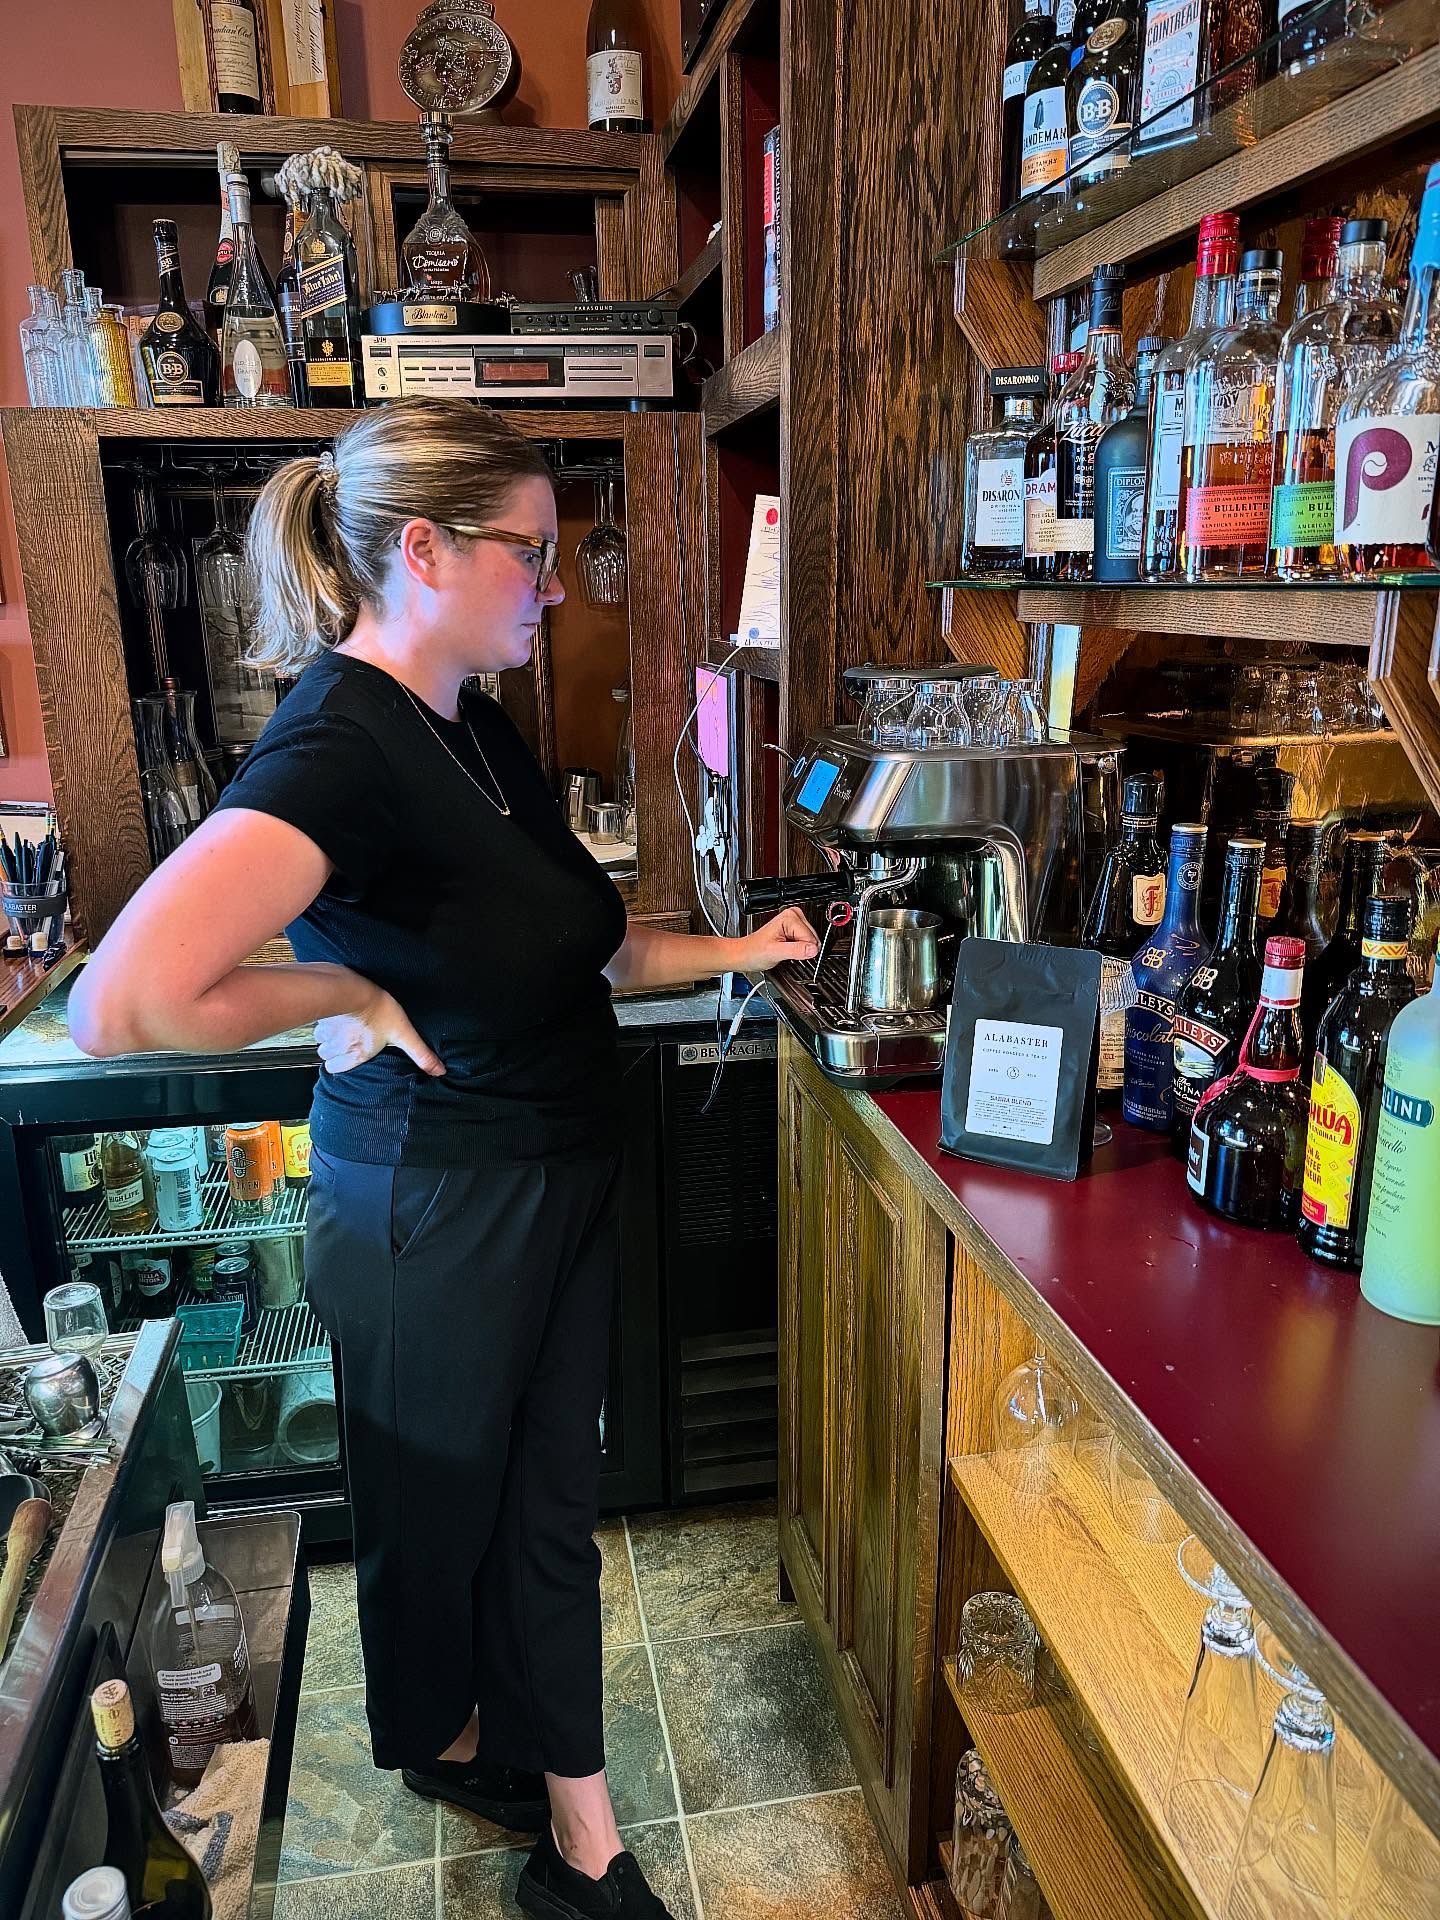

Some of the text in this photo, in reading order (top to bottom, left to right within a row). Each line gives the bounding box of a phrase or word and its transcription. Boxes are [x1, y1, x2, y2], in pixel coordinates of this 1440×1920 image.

[213, 25, 237, 36] nadian
[1147, 0, 1200, 48] COINTREAU
[1023, 127, 1067, 151] ANDEMAN
[303, 270, 342, 296] Blue Label
[995, 374, 1040, 386] DISARONNO
[1060, 421, 1107, 445] Zaca
[982, 489, 1021, 502] DISARON
[1025, 482, 1056, 496] DRAM
[1222, 511, 1264, 519] FRONTIER
[1308, 502, 1334, 512] BUL
[1139, 993, 1175, 1016] LEYS
[984, 1033, 1048, 1048] ALABASTER
[1174, 1018, 1217, 1048] ILEYS
[1381, 1085, 1423, 1122] LINI
[1310, 1100, 1351, 1146] HLÚA
[1306, 1158, 1321, 1174] FFEE
[108, 1189, 139, 1203] HIGH LIFE
